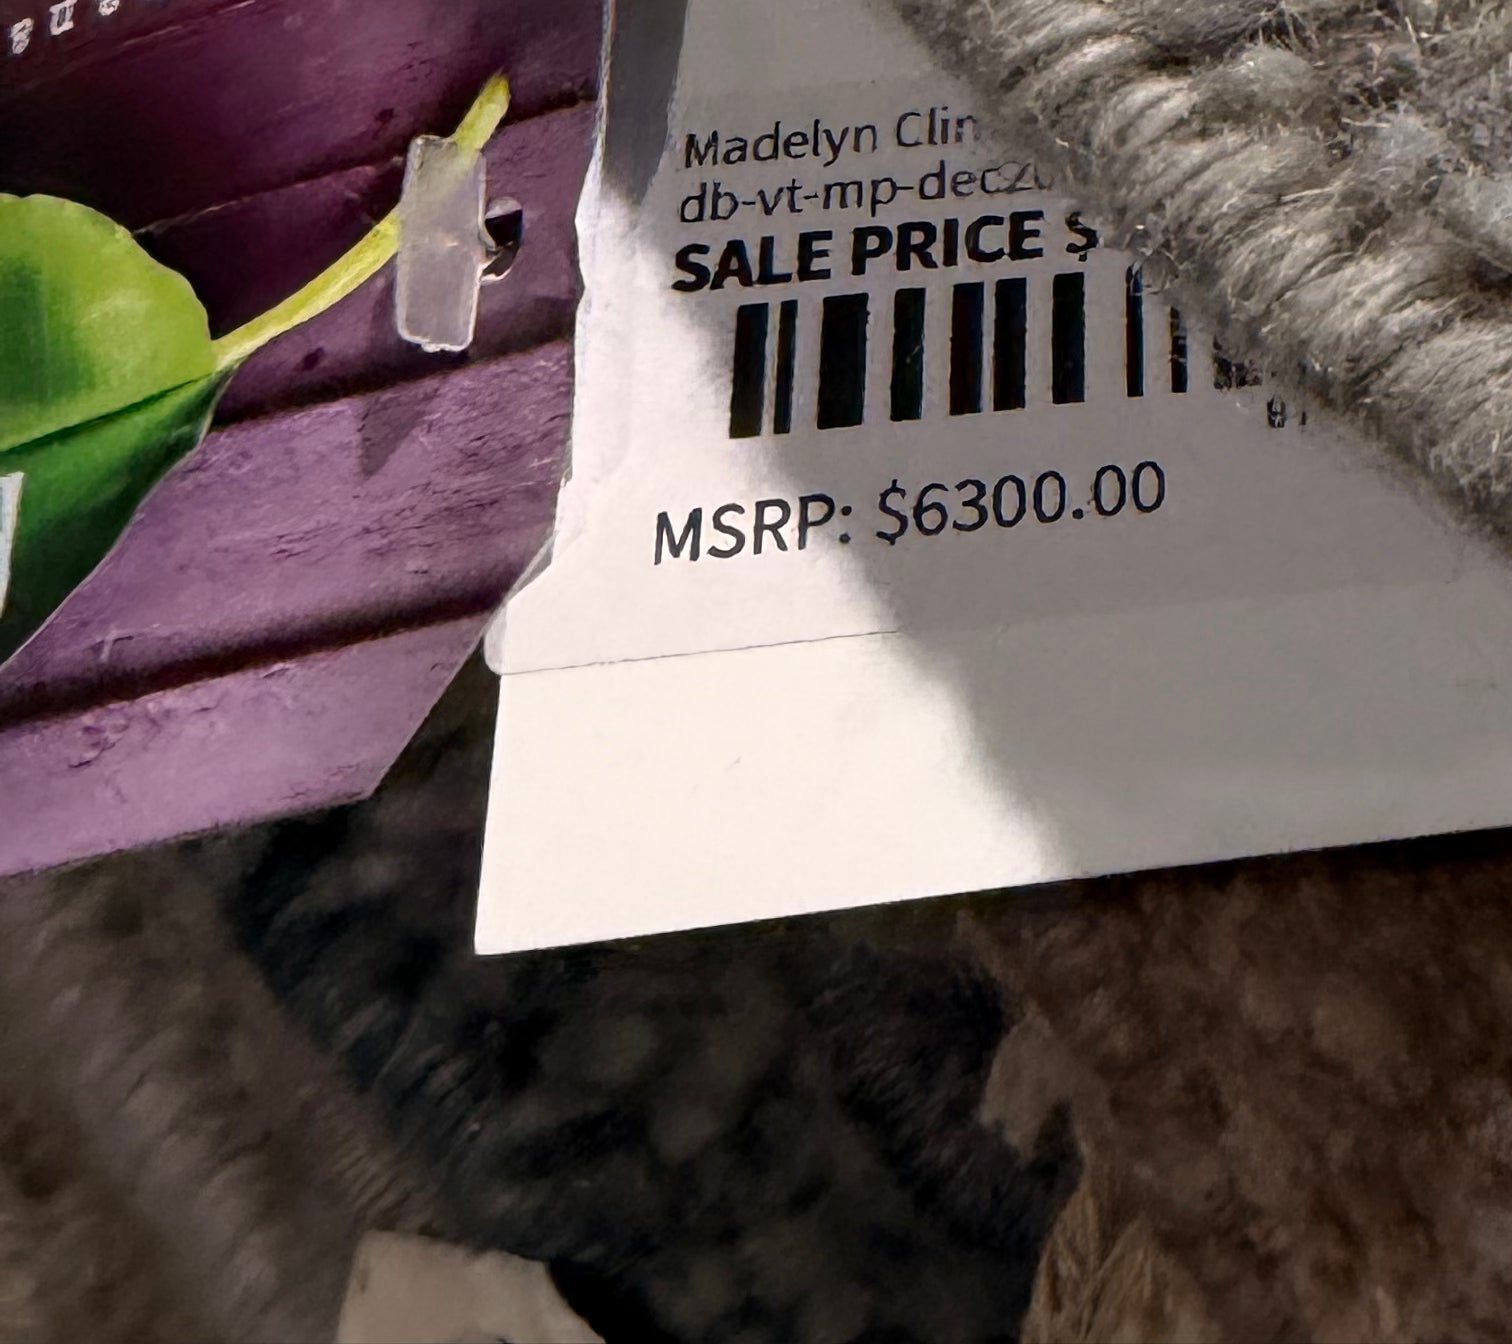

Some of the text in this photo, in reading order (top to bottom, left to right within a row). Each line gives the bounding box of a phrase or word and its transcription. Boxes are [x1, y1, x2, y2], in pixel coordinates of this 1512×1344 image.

[684, 119, 877, 169] Madelyn
[671, 230, 834, 292] SALE
[850, 209, 1046, 276] PRICE
[653, 459, 1167, 566] MSRP: $6300.00
